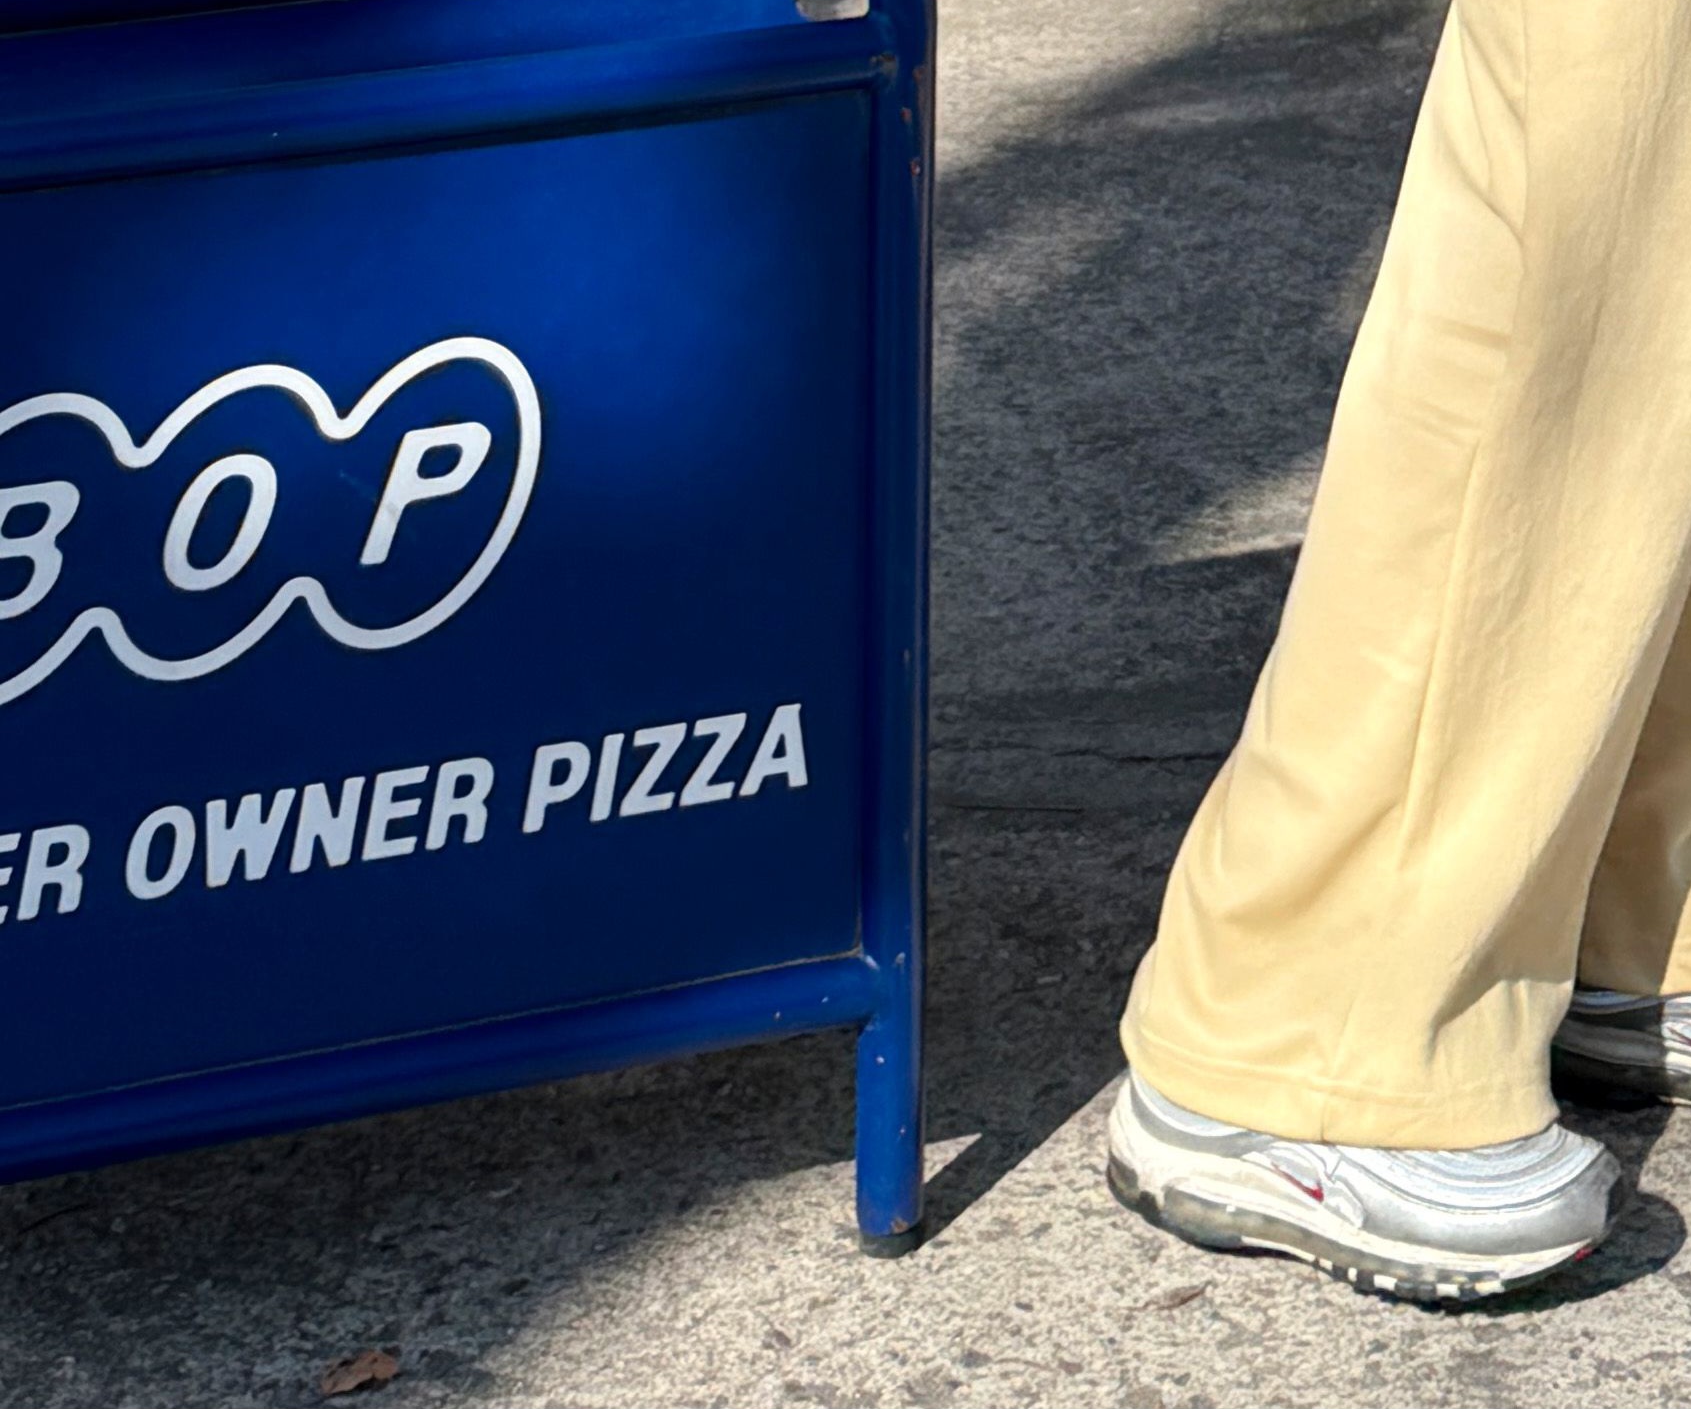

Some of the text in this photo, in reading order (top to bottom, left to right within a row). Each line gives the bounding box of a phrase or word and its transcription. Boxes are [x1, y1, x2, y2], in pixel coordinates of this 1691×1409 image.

[0, 422, 491, 619] BOP
[125, 757, 495, 899] OWNER
[522, 703, 808, 833] PIZZA
